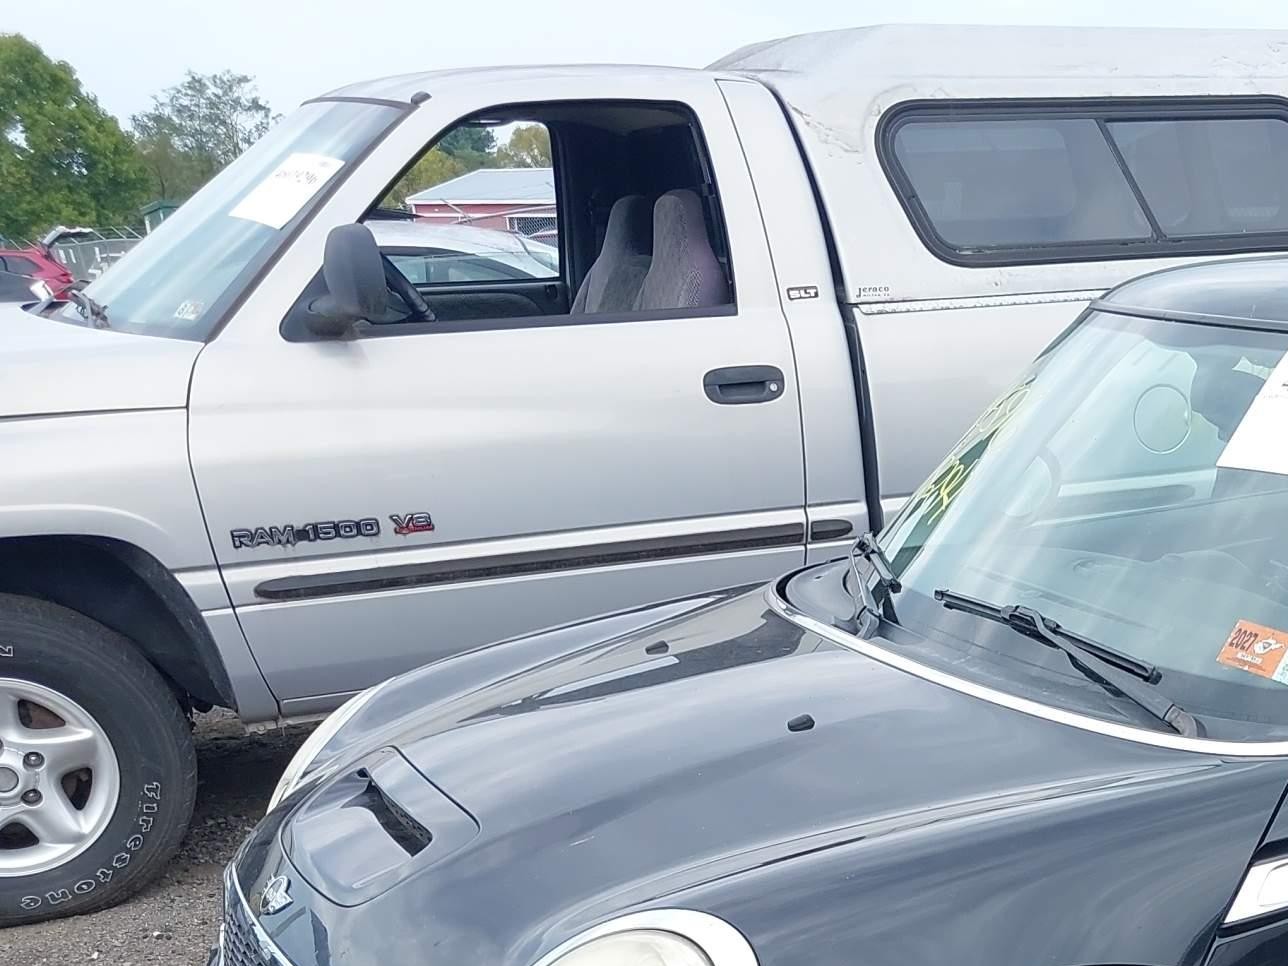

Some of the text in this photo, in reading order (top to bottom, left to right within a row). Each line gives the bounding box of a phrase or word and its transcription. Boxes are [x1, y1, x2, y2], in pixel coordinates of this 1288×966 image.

[788, 287, 818, 299] SLT
[230, 524, 297, 550] RAM
[301, 517, 381, 543] 1500
[389, 511, 433, 529] V8
[1228, 627, 1259, 653] 2027
[20, 781, 161, 910] Firestone
